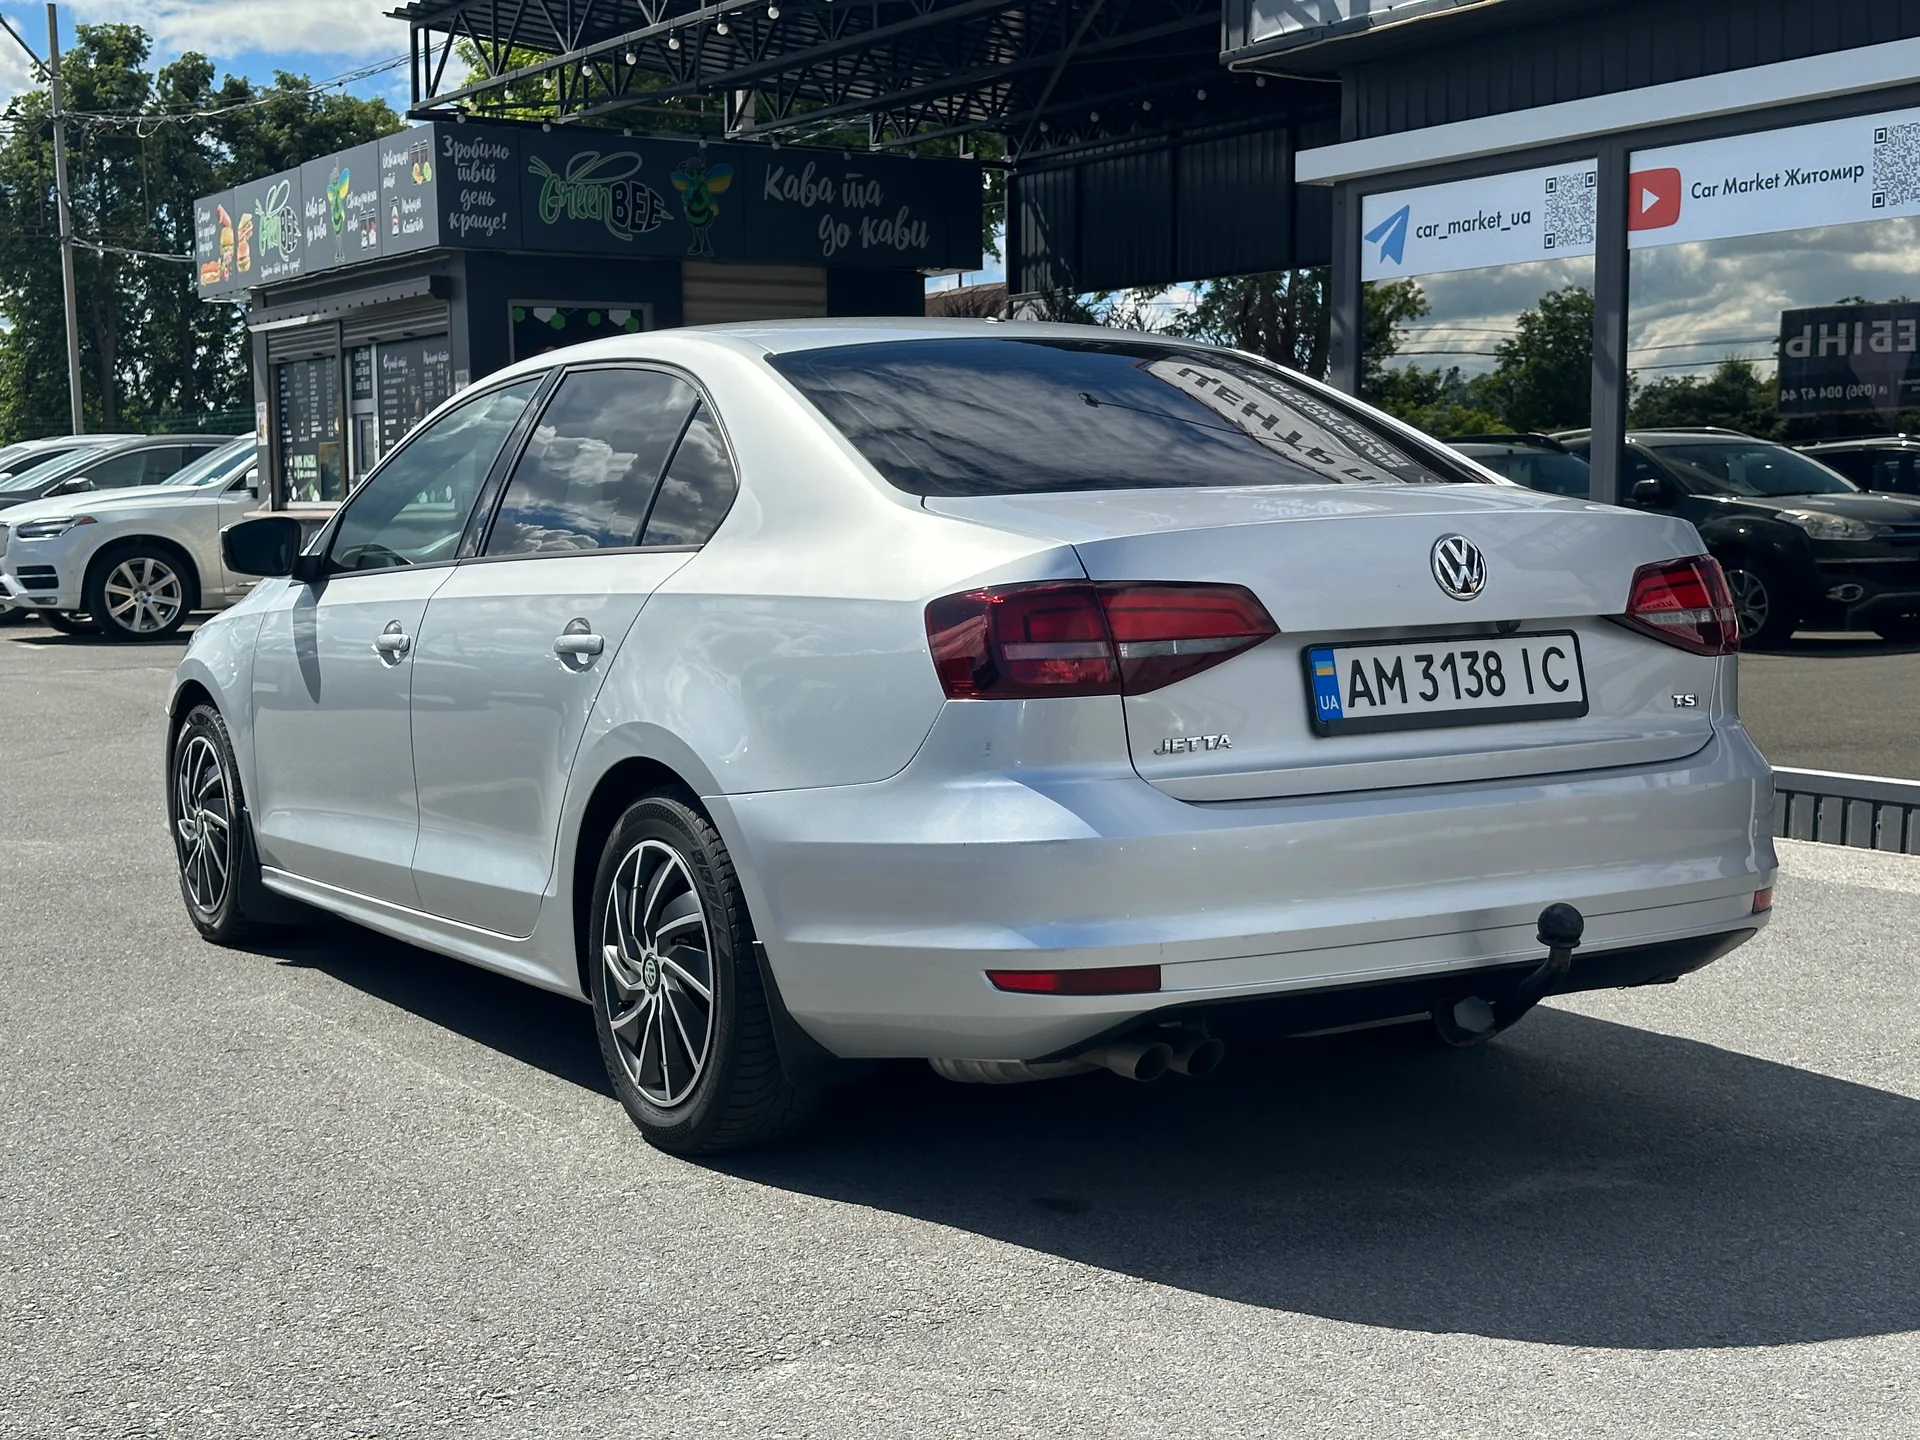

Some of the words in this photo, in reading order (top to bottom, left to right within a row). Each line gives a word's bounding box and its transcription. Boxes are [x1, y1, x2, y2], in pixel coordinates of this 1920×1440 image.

[442, 135, 510, 165] Зробимо
[457, 159, 497, 183] твій
[764, 161, 836, 207] Кава
[842, 173, 884, 209] та
[1691, 182, 1718, 199] Car
[1722, 172, 1780, 196] Market
[1784, 164, 1865, 188] Житомир
[460, 189, 496, 211] день
[448, 212, 507, 238] краще!
[819, 213, 851, 257] до
[859, 206, 930, 250] кави
[1416, 210, 1531, 240] car_market_ua
[1348, 655, 1408, 708] AM
[1414, 650, 1506, 702] 3138
[1320, 695, 1339, 710] UA
[1153, 734, 1233, 756] JETTA
